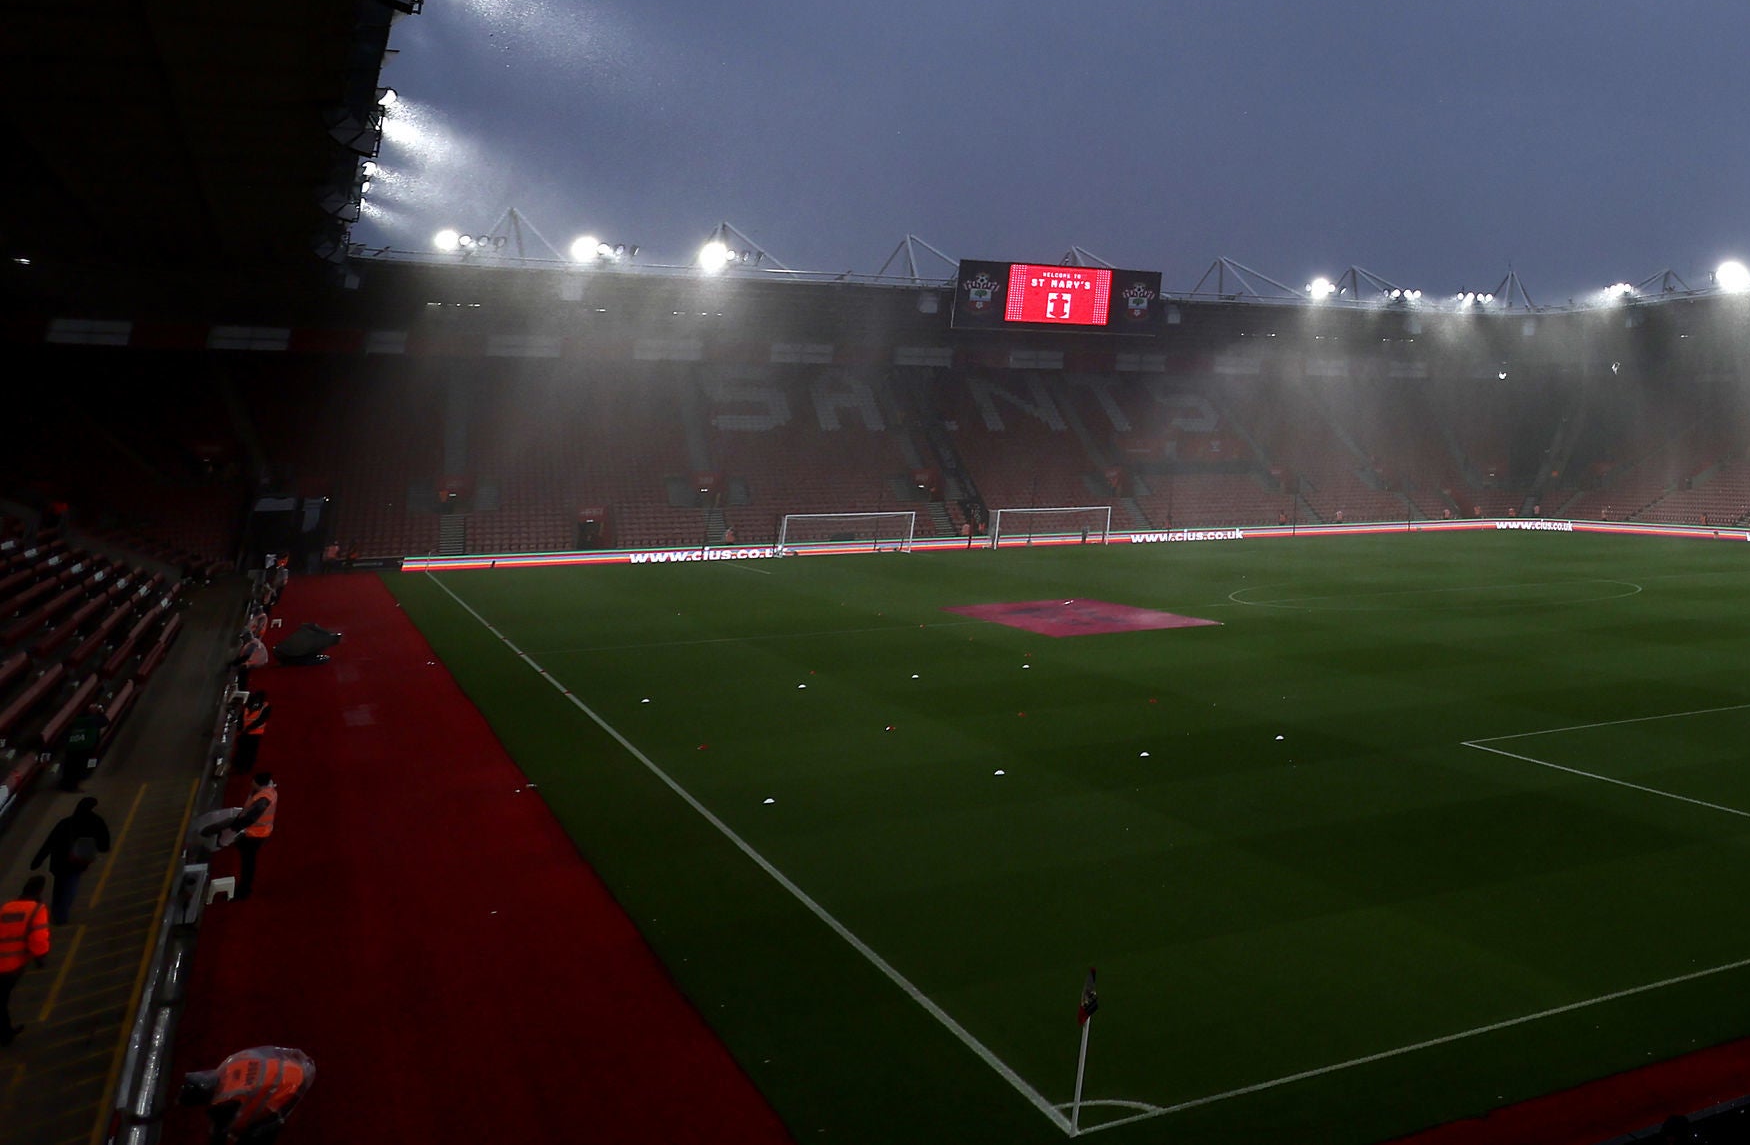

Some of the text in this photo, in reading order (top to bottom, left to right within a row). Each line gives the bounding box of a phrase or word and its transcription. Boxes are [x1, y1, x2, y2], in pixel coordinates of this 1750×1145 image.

[1031, 278, 1090, 289] ST MARY'S
[712, 367, 1220, 432] SANTS
[1495, 519, 1573, 532] www.cius.co.uk
[1130, 528, 1244, 544] www.cius.co.uk
